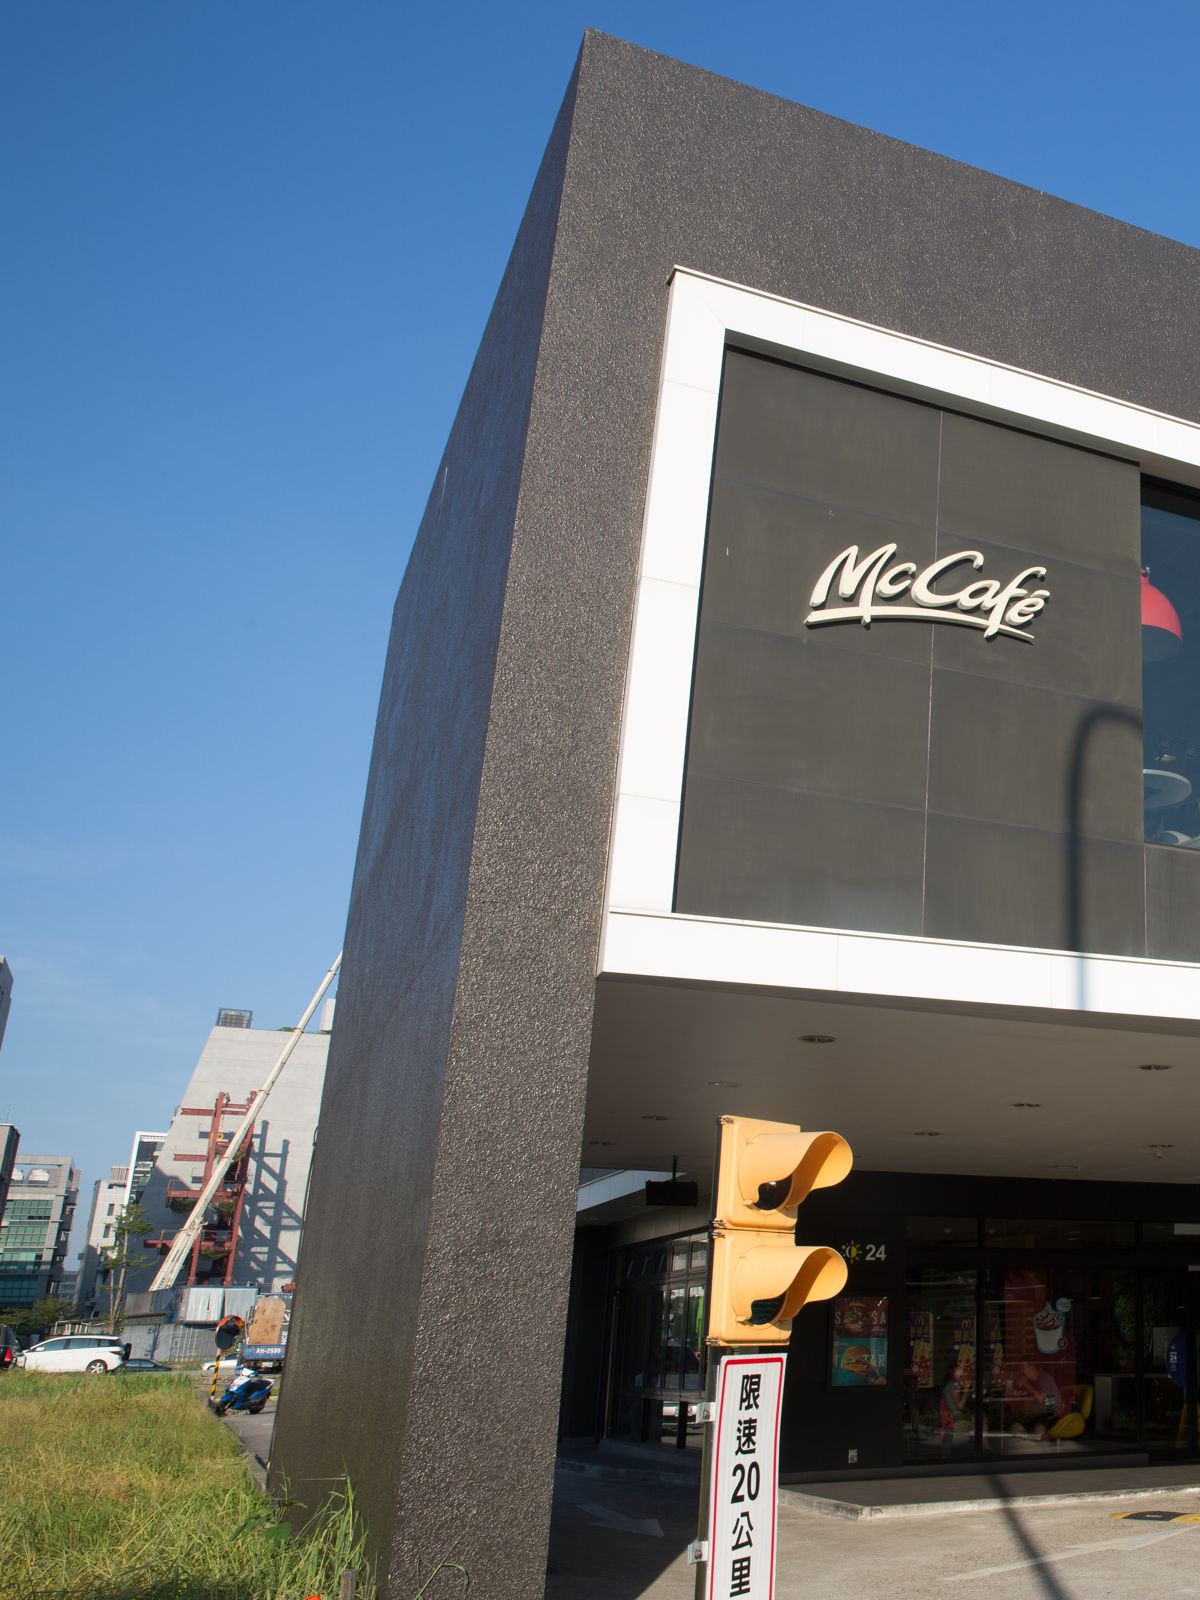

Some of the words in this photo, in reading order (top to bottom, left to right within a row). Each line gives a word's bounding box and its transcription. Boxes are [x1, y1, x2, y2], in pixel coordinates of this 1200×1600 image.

[803, 542, 1051, 642] McCafé
[865, 1243, 887, 1262] 24
[729, 1373, 762, 1598] 限速20公里
